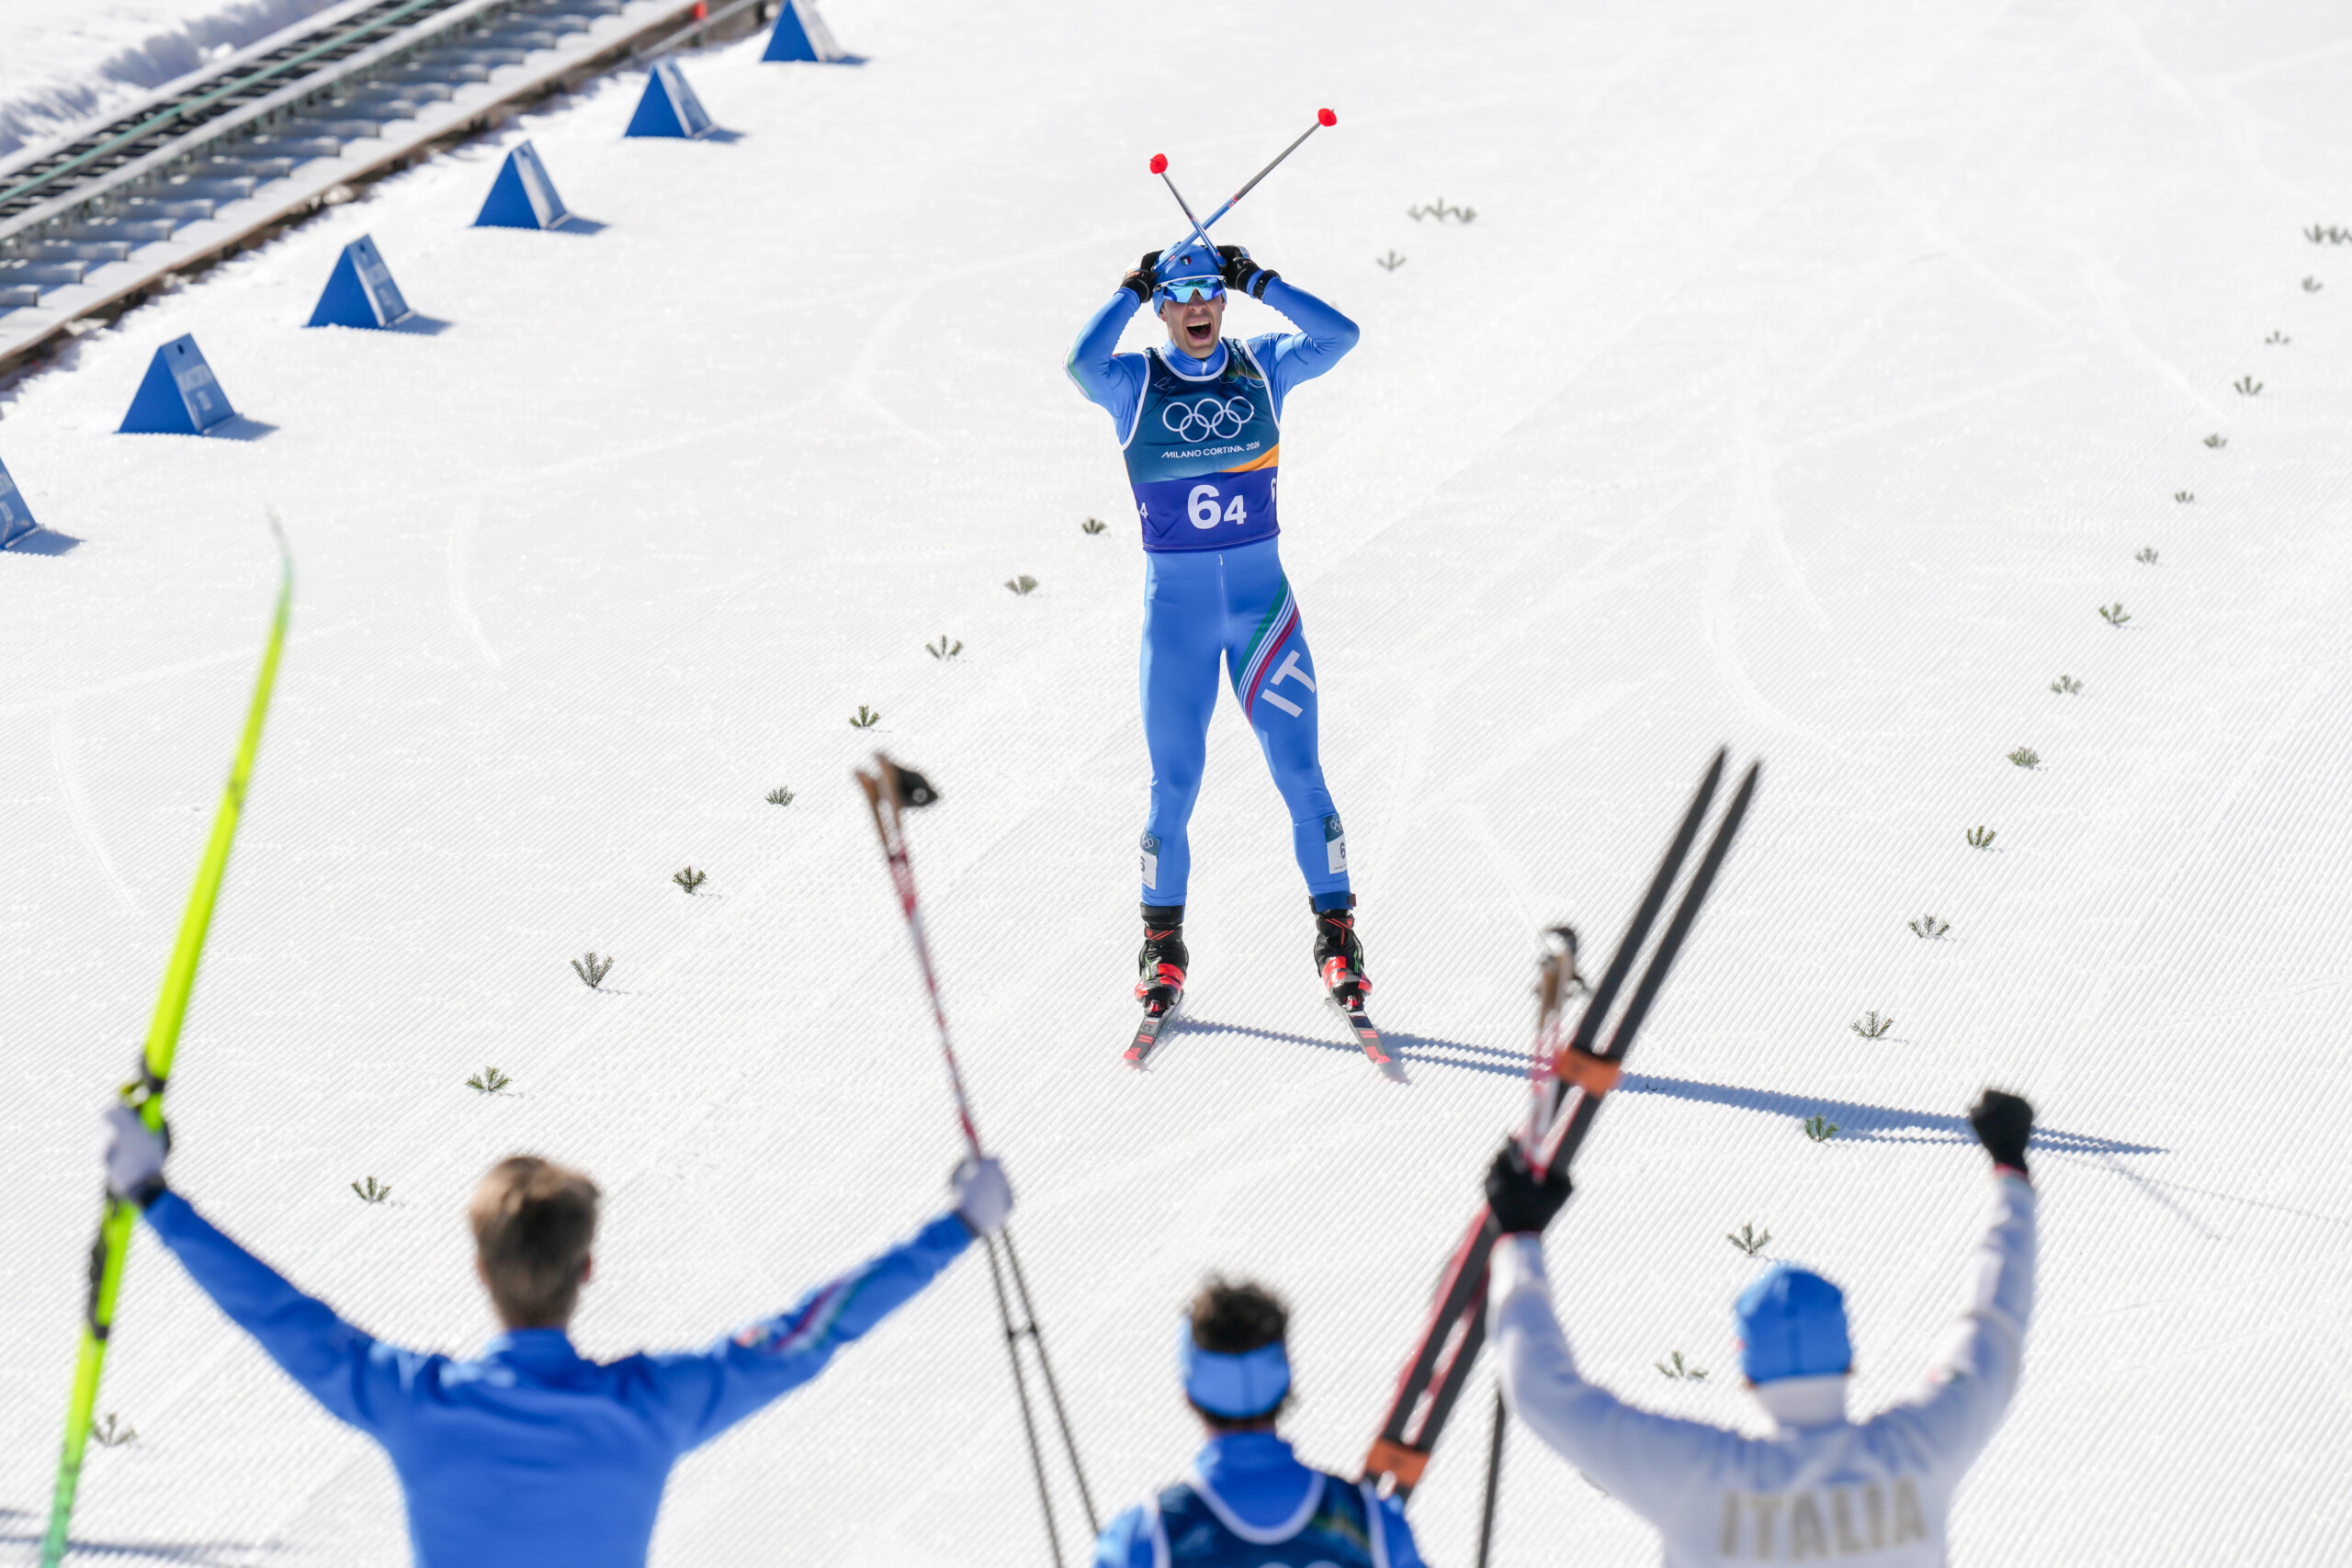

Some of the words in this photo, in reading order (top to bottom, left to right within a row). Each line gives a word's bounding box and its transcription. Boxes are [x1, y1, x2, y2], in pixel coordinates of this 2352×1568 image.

[1161, 449, 1202, 458] MILANO
[1203, 446, 1244, 456] CORTINA
[1246, 441, 1261, 451] 2026
[1261, 649, 1317, 718] IT
[1340, 841, 1346, 860] 6
[1717, 1474, 1929, 1560] ITALIA
